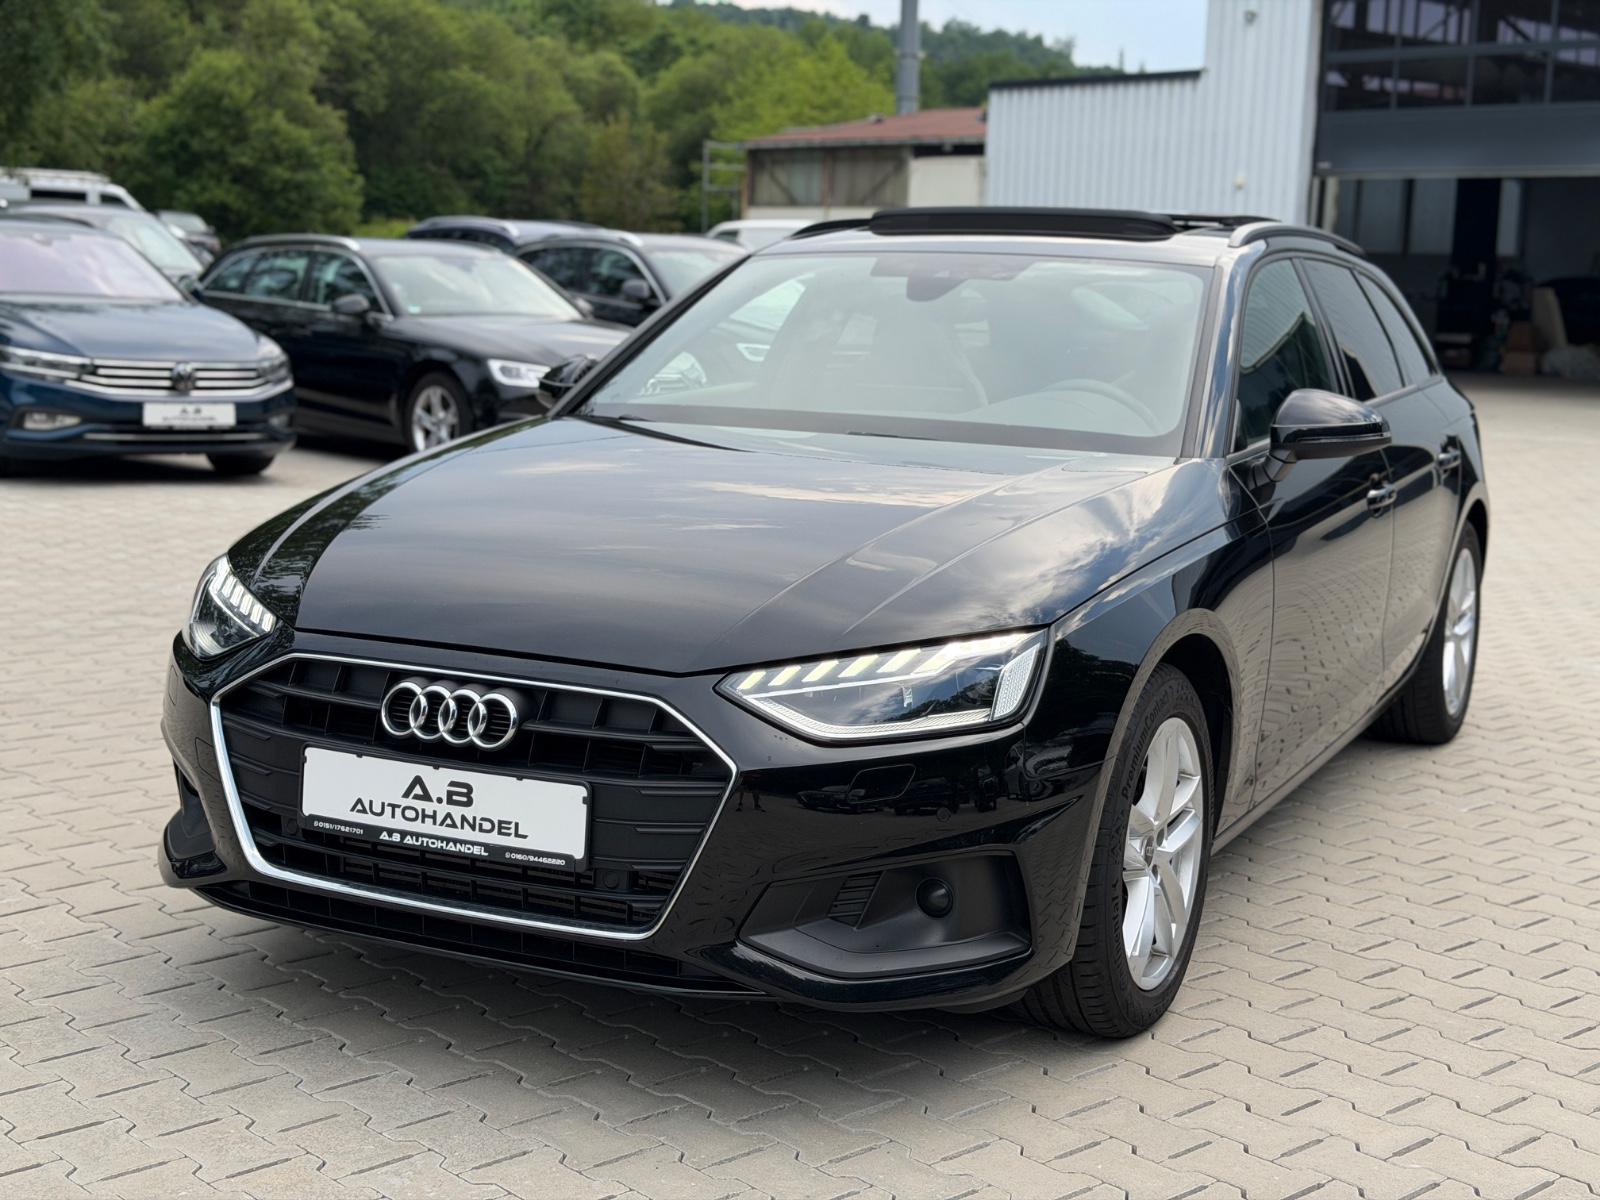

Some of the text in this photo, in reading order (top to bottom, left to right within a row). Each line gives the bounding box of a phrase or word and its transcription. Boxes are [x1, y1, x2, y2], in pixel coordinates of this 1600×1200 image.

[401, 775, 474, 808] A.B
[350, 797, 529, 840] AUTOHANDEL
[379, 831, 489, 856] A.B AUTOHANDEL
